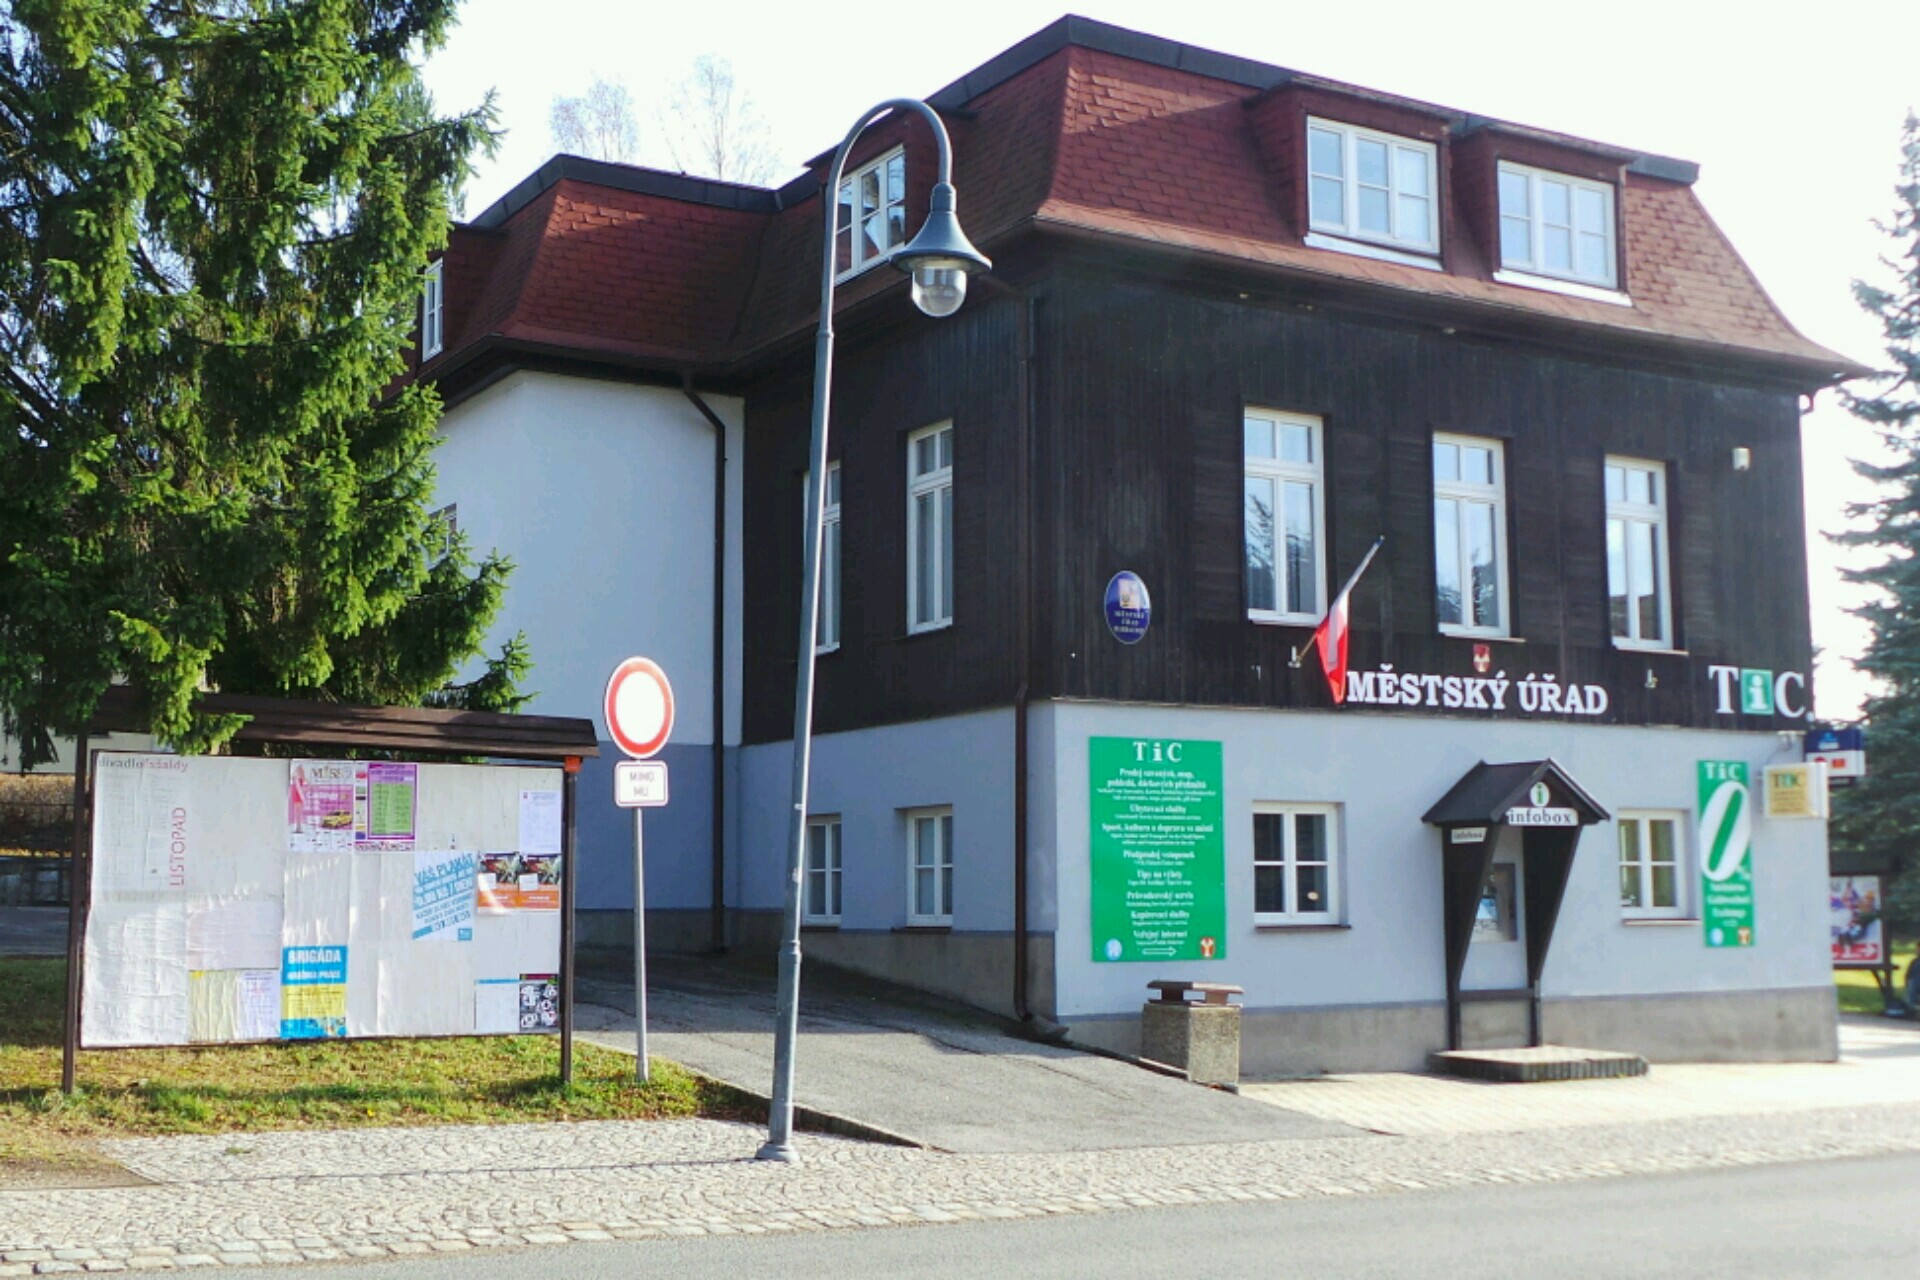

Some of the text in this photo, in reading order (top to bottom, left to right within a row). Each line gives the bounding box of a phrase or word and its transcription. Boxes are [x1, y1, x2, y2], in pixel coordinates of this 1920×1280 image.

[1346, 663, 1609, 714] MĚSTSKÝ ÚŘAD
[1708, 665, 1806, 718] TiC
[1133, 741, 1182, 762] TiC
[1704, 762, 1741, 780] TiC
[1509, 809, 1572, 825] infobox
[169, 807, 187, 886] LISTOPAD
